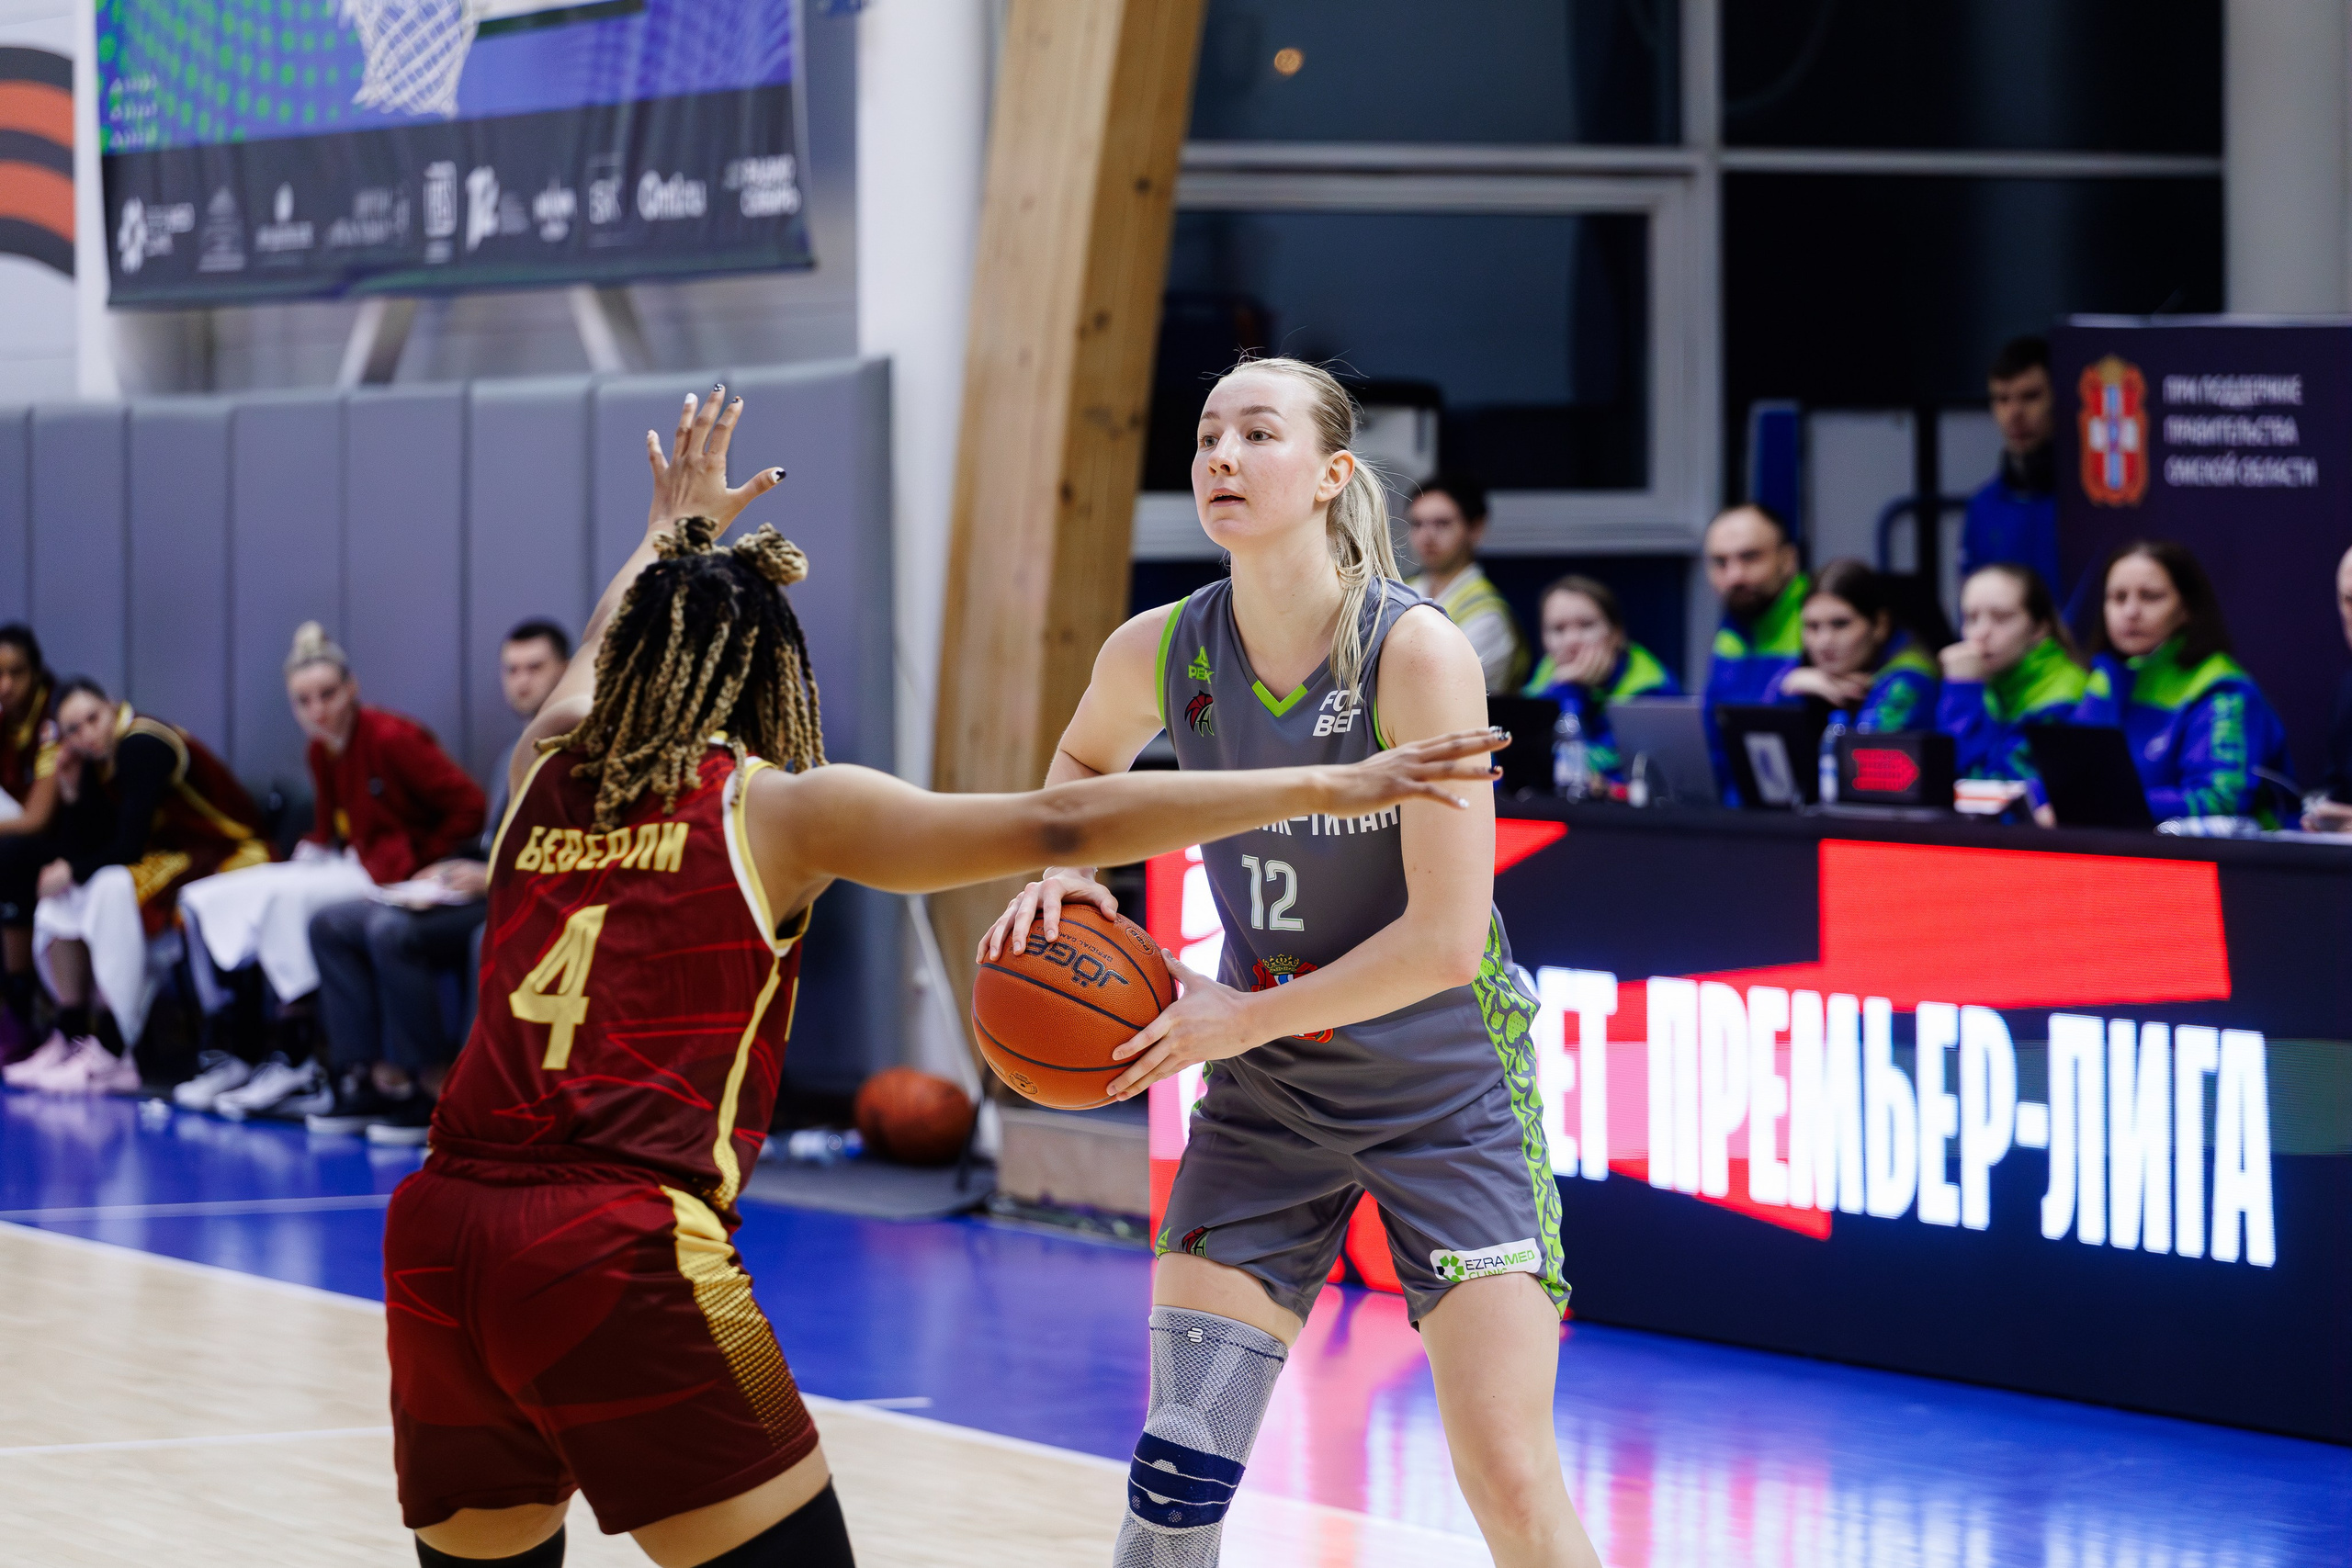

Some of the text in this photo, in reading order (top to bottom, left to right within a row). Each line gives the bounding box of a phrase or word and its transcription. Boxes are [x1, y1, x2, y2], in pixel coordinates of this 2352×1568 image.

[1313, 708, 1362, 737] BET
[515, 822, 689, 873] БЕВЕРЛИ
[1241, 854, 1305, 931] 12
[509, 904, 609, 1070] 4
[1024, 933, 1130, 988] JÖGE
[1646, 976, 2277, 1269] ПРЕМЬЕР-ЛИГА
[1464, 1249, 1535, 1270] EZRAMED
